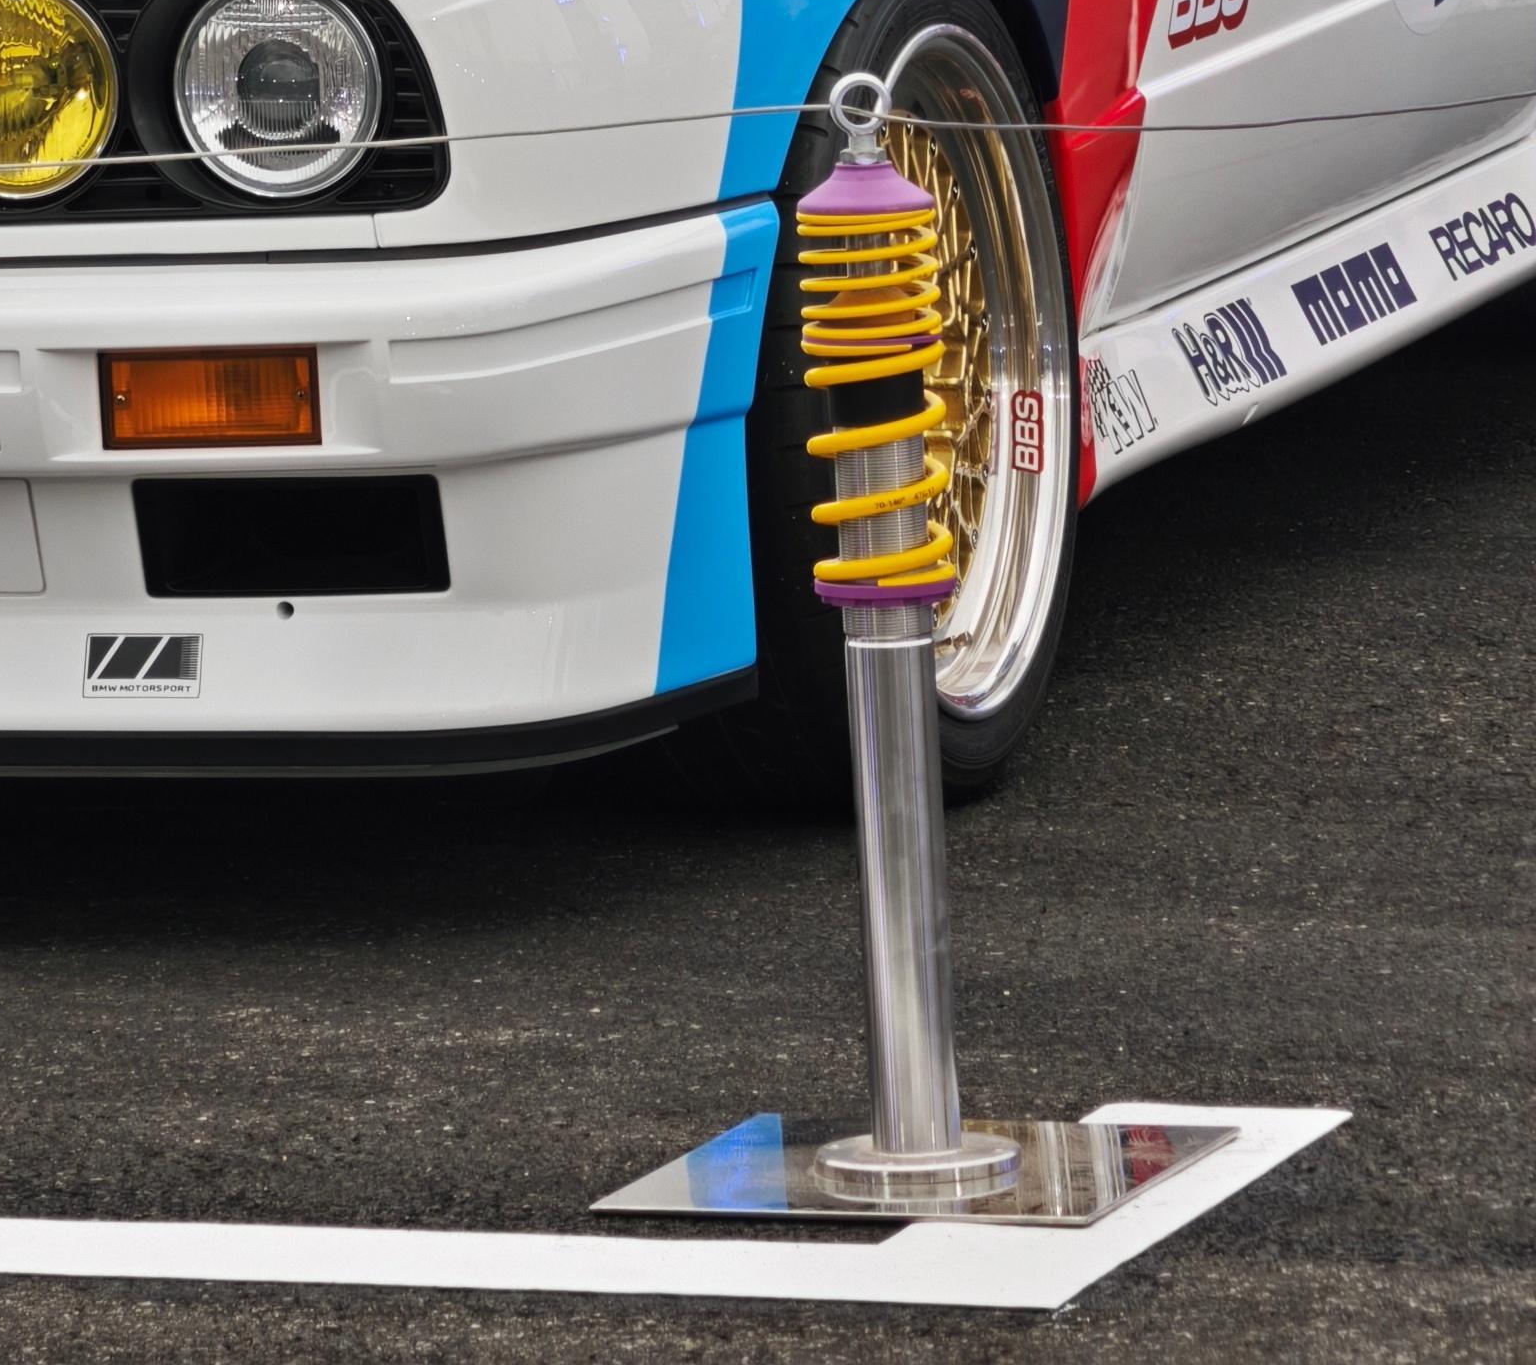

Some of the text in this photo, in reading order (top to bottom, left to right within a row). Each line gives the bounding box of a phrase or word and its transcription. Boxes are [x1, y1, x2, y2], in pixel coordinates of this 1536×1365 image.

[1428, 191, 1536, 282] RECARO
[1171, 312, 1261, 407] H&R
[1013, 392, 1042, 473] BBS
[91, 684, 193, 693] BMW MOTORSPORT
